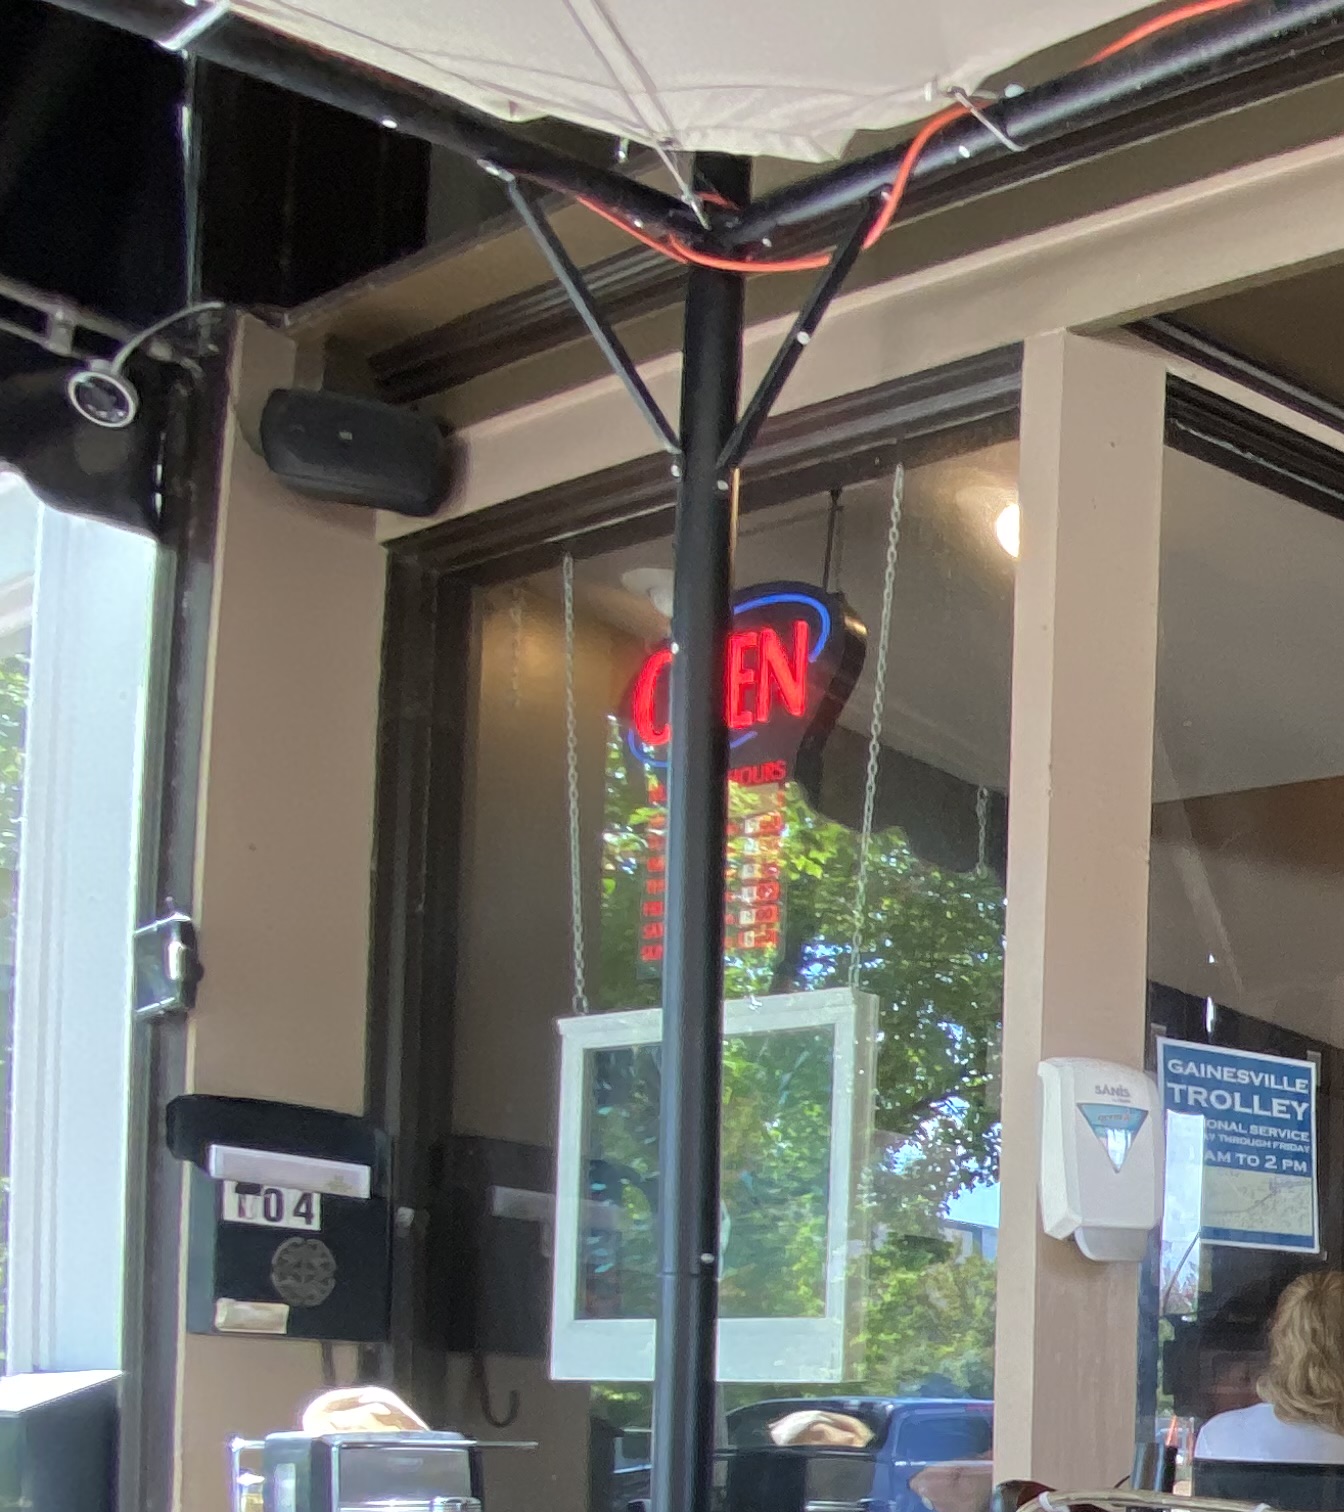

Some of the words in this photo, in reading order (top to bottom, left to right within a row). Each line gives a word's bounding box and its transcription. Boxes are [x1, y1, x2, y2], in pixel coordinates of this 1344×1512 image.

[1167, 1058, 1309, 1095] GAINESVILLE
[1166, 1082, 1310, 1121] TROLLEY
[1250, 1125, 1310, 1142] SERVICE
[1219, 1135, 1271, 1148] THROUGH
[1273, 1142, 1310, 1153] FRIDAY
[1236, 1153, 1260, 1167] TO
[1264, 1155, 1278, 1169] 2
[1282, 1159, 1307, 1172] PM
